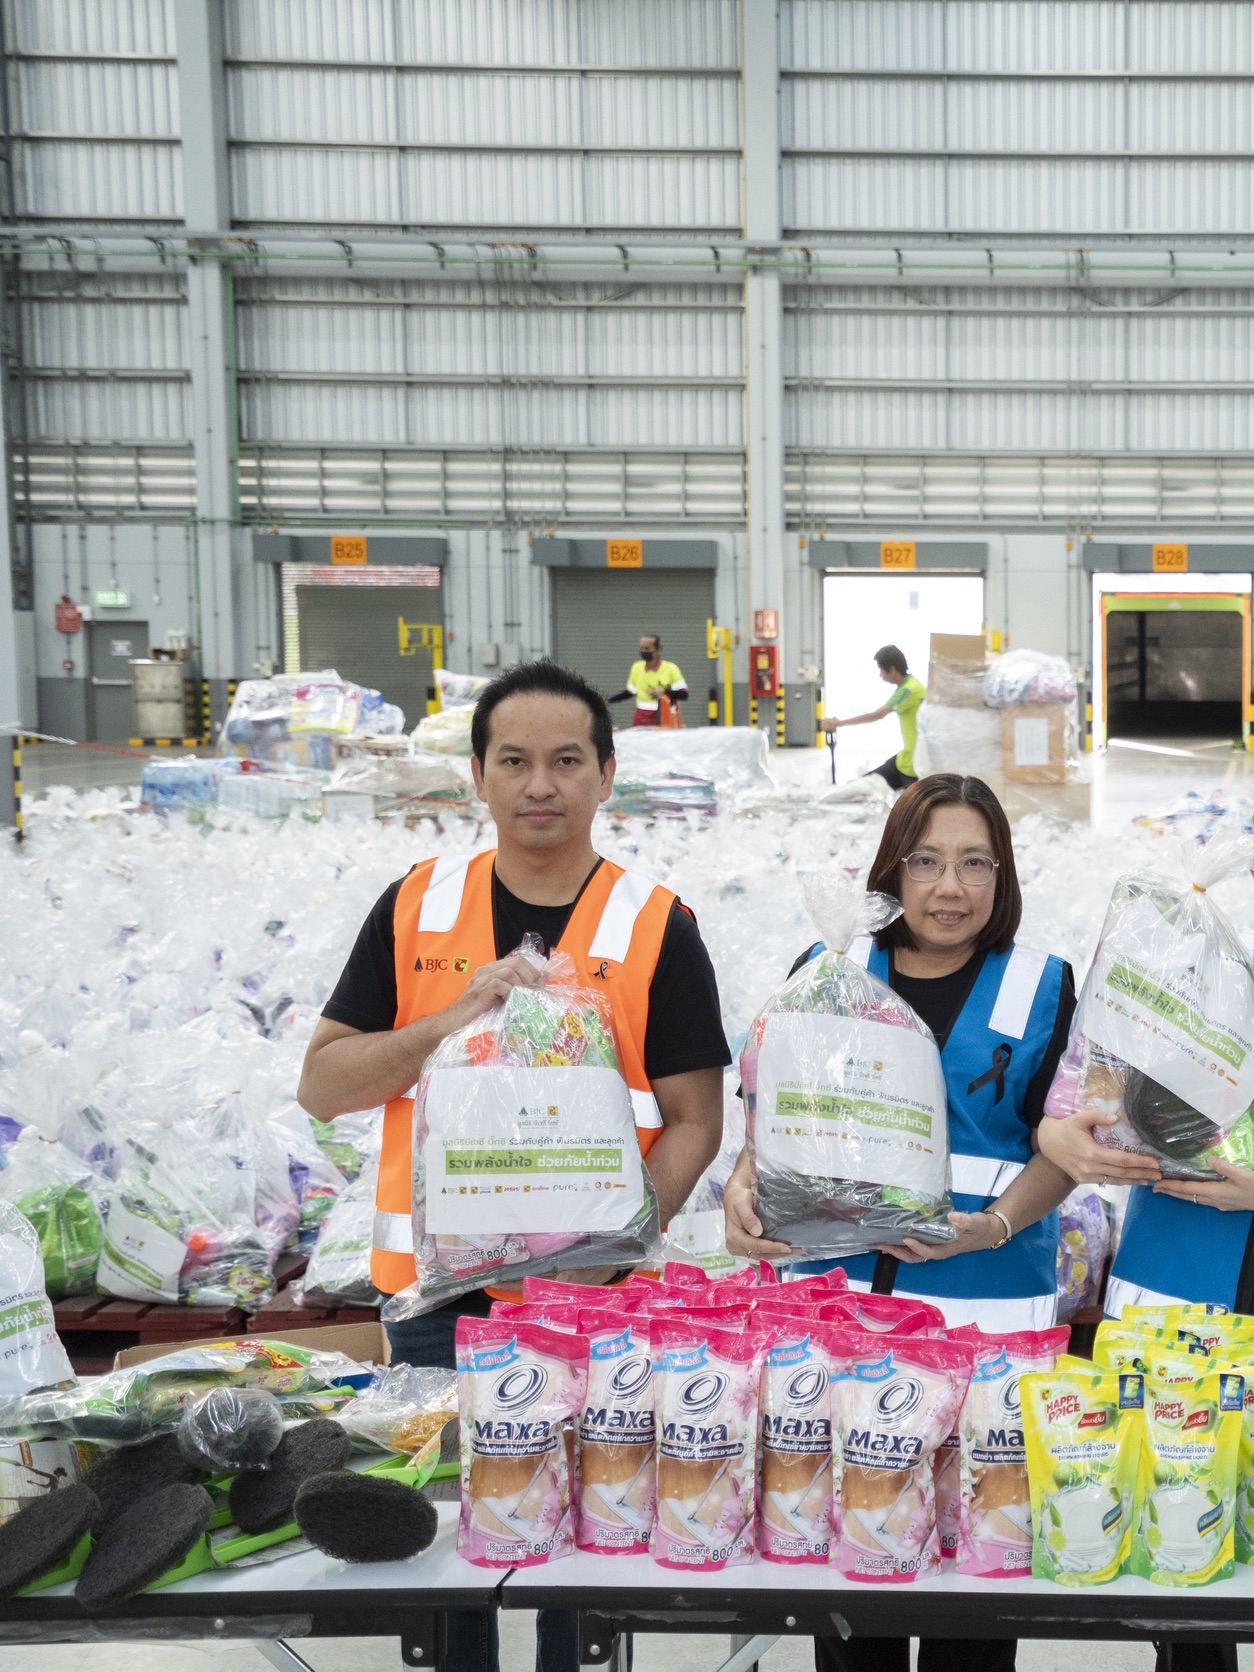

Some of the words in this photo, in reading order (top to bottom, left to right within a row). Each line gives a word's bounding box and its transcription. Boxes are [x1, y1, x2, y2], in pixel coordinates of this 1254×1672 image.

[335, 543, 364, 558] B25
[611, 546, 639, 561] B26
[884, 548, 911, 564] B27
[1156, 550, 1184, 565] B28
[425, 958, 448, 973] BJC
[448, 1151, 532, 1169] รวมพลังน้ำใจ
[537, 1151, 620, 1168] ช่วยภัยน้ำท่วม
[486, 1246, 508, 1262] 800
[1046, 1394, 1079, 1412] HAPPY
[1154, 1401, 1183, 1411] HAPPY
[583, 1407, 655, 1429] Maxa
[1047, 1402, 1082, 1424] PRICE
[1154, 1409, 1185, 1421] PRICE
[475, 1420, 551, 1440] Maxa
[662, 1422, 728, 1444] Maxa
[764, 1413, 832, 1437] Maxa
[847, 1428, 923, 1456] Maxa
[595, 1528, 640, 1540] ปริมาตรสุทธิ
[486, 1541, 533, 1553] ปริมาตรสุทธิ
[534, 1539, 554, 1555] 800
[771, 1537, 813, 1549] ปริมาตรสุทธิ
[668, 1543, 710, 1555] ปริมาตรสุทธิ
[712, 1546, 733, 1562] 800
[856, 1555, 899, 1567] ปริมาตรสุทธิ
[901, 1558, 922, 1573] 800
